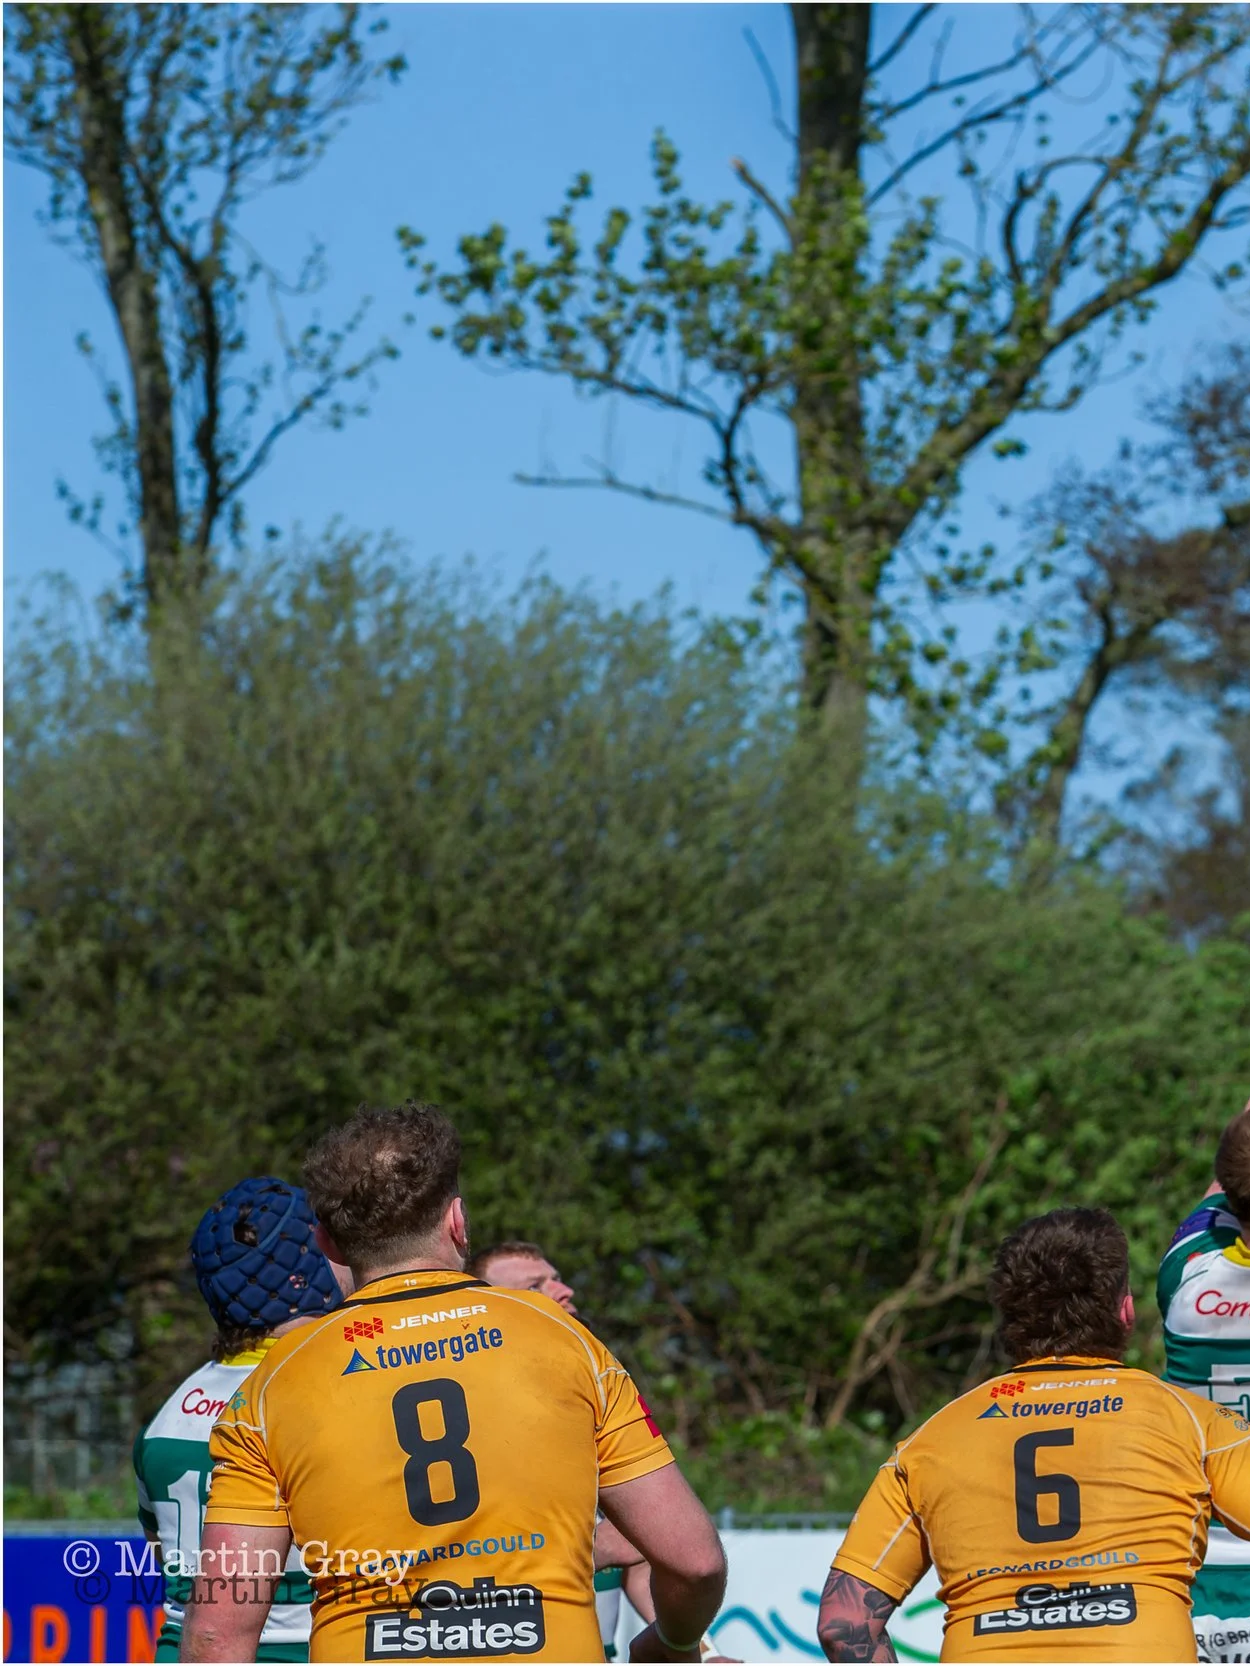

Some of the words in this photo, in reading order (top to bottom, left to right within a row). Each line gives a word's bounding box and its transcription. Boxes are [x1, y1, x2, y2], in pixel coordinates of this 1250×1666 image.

[391, 1304, 488, 1330] JENNER
[376, 1326, 504, 1370] towergate
[1031, 1377, 1119, 1391] JENNER
[182, 1388, 229, 1417] Com
[1012, 1394, 1124, 1419] towergate
[392, 1378, 480, 1527] 8
[1013, 1427, 1081, 1544] 6
[167, 1470, 212, 1574] 1
[421, 1584, 535, 1612] Quinn
[980, 1600, 1132, 1629] Estates
[373, 1618, 540, 1653] Estates
